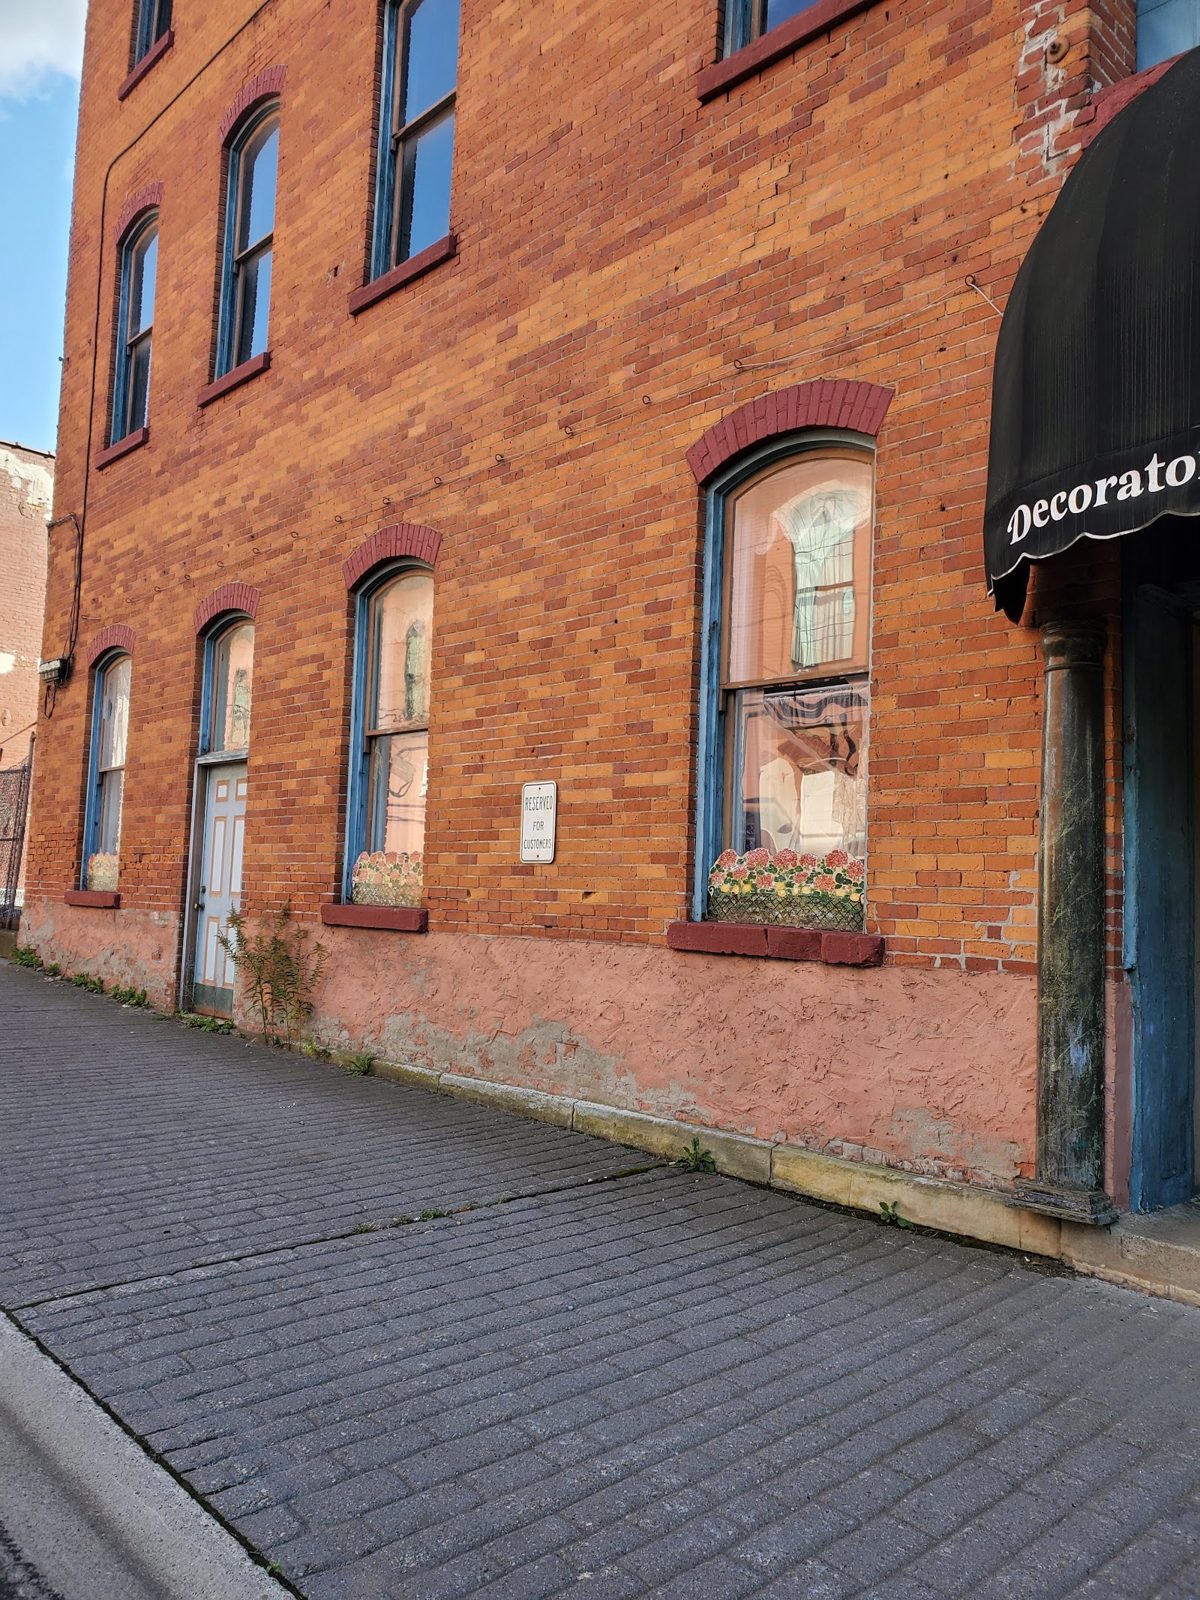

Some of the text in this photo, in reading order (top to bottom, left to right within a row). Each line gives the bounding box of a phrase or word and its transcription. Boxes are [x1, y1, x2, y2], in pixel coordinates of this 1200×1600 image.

[1007, 451, 1200, 545] Decorato
[525, 795, 553, 811] RESERVED
[532, 821, 545, 831] FOR
[523, 839, 552, 850] CUSTOMERS
